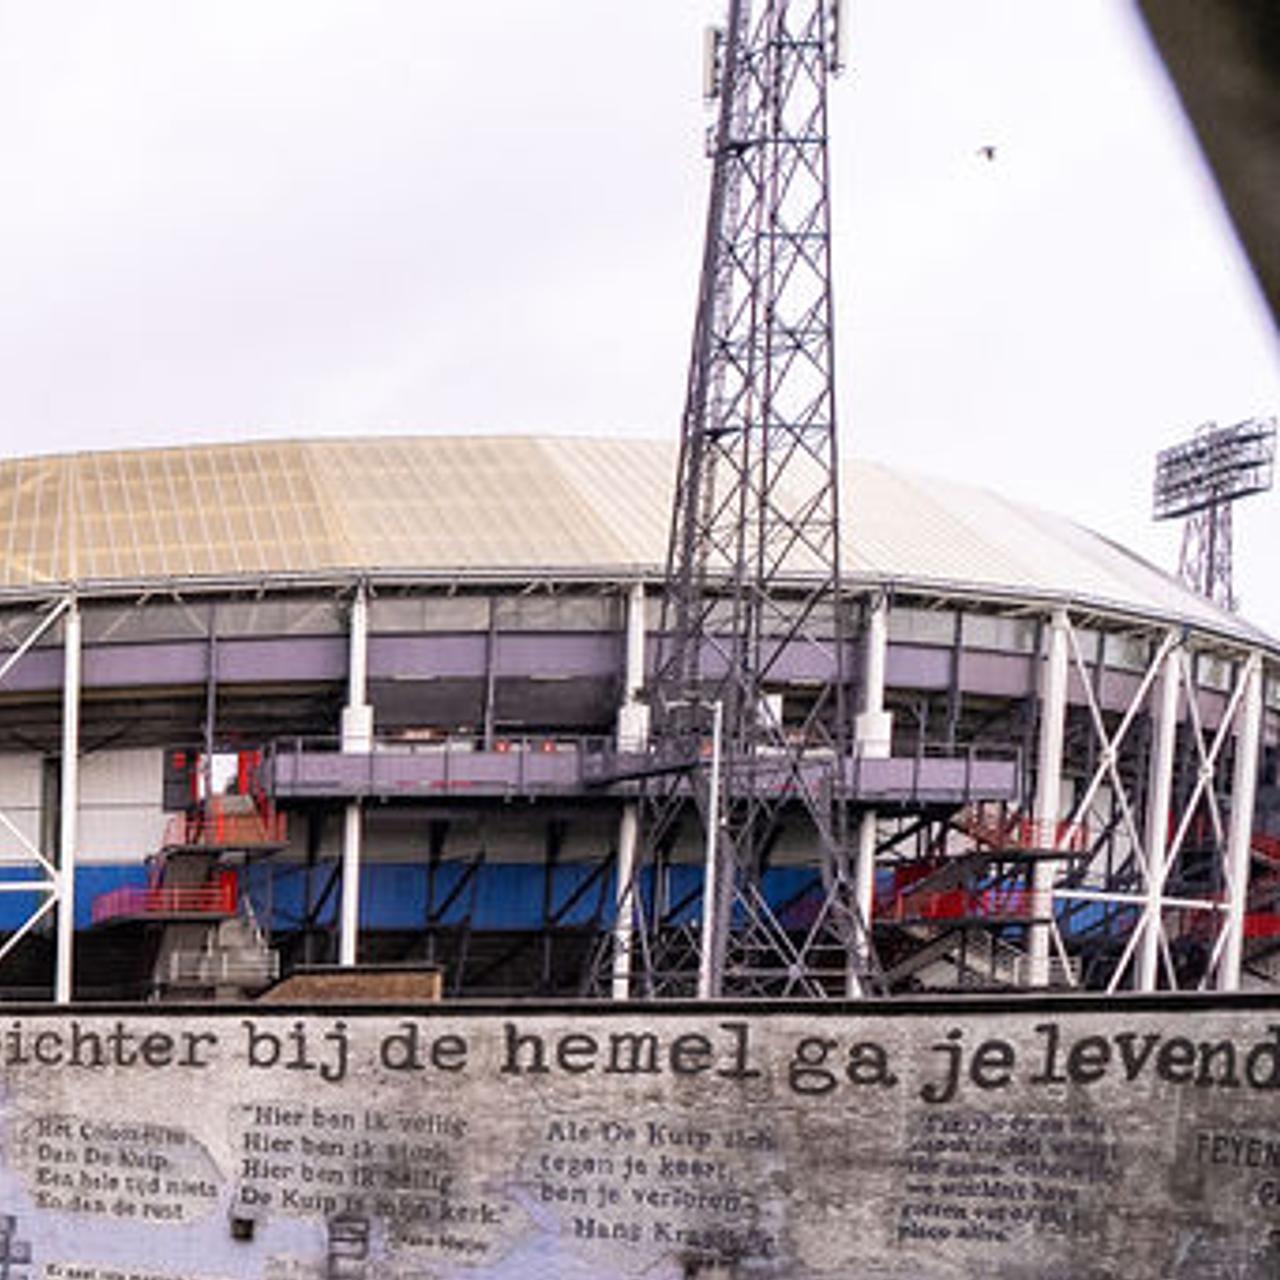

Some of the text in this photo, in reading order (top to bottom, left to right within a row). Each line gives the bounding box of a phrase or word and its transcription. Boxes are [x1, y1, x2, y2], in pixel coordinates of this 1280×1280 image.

[242, 1020, 349, 1082] bij
[380, 1023, 469, 1071] de
[499, 1022, 762, 1079] hemel
[789, 1036, 899, 1094] ga
[920, 1028, 1017, 1103] je
[1029, 1022, 1280, 1090] levend
[312, 1108, 356, 1131] ben
[364, 1111, 391, 1131] ik
[242, 1132, 295, 1153] Hier
[301, 1136, 345, 1157] ben
[352, 1139, 378, 1159] ik
[545, 1121, 590, 1143] Als
[601, 1121, 637, 1143] De
[647, 1122, 714, 1151] Kuip
[241, 1159, 296, 1180] Hier
[301, 1162, 345, 1184] ben
[352, 1166, 376, 1187] ik
[540, 1153, 615, 1179] tegen
[622, 1155, 649, 1180] je
[240, 1186, 273, 1206] De
[282, 1188, 338, 1215] Kuip
[540, 1180, 590, 1204] ben
[595, 1183, 623, 1209] je
[572, 1216, 642, 1243] Hans
